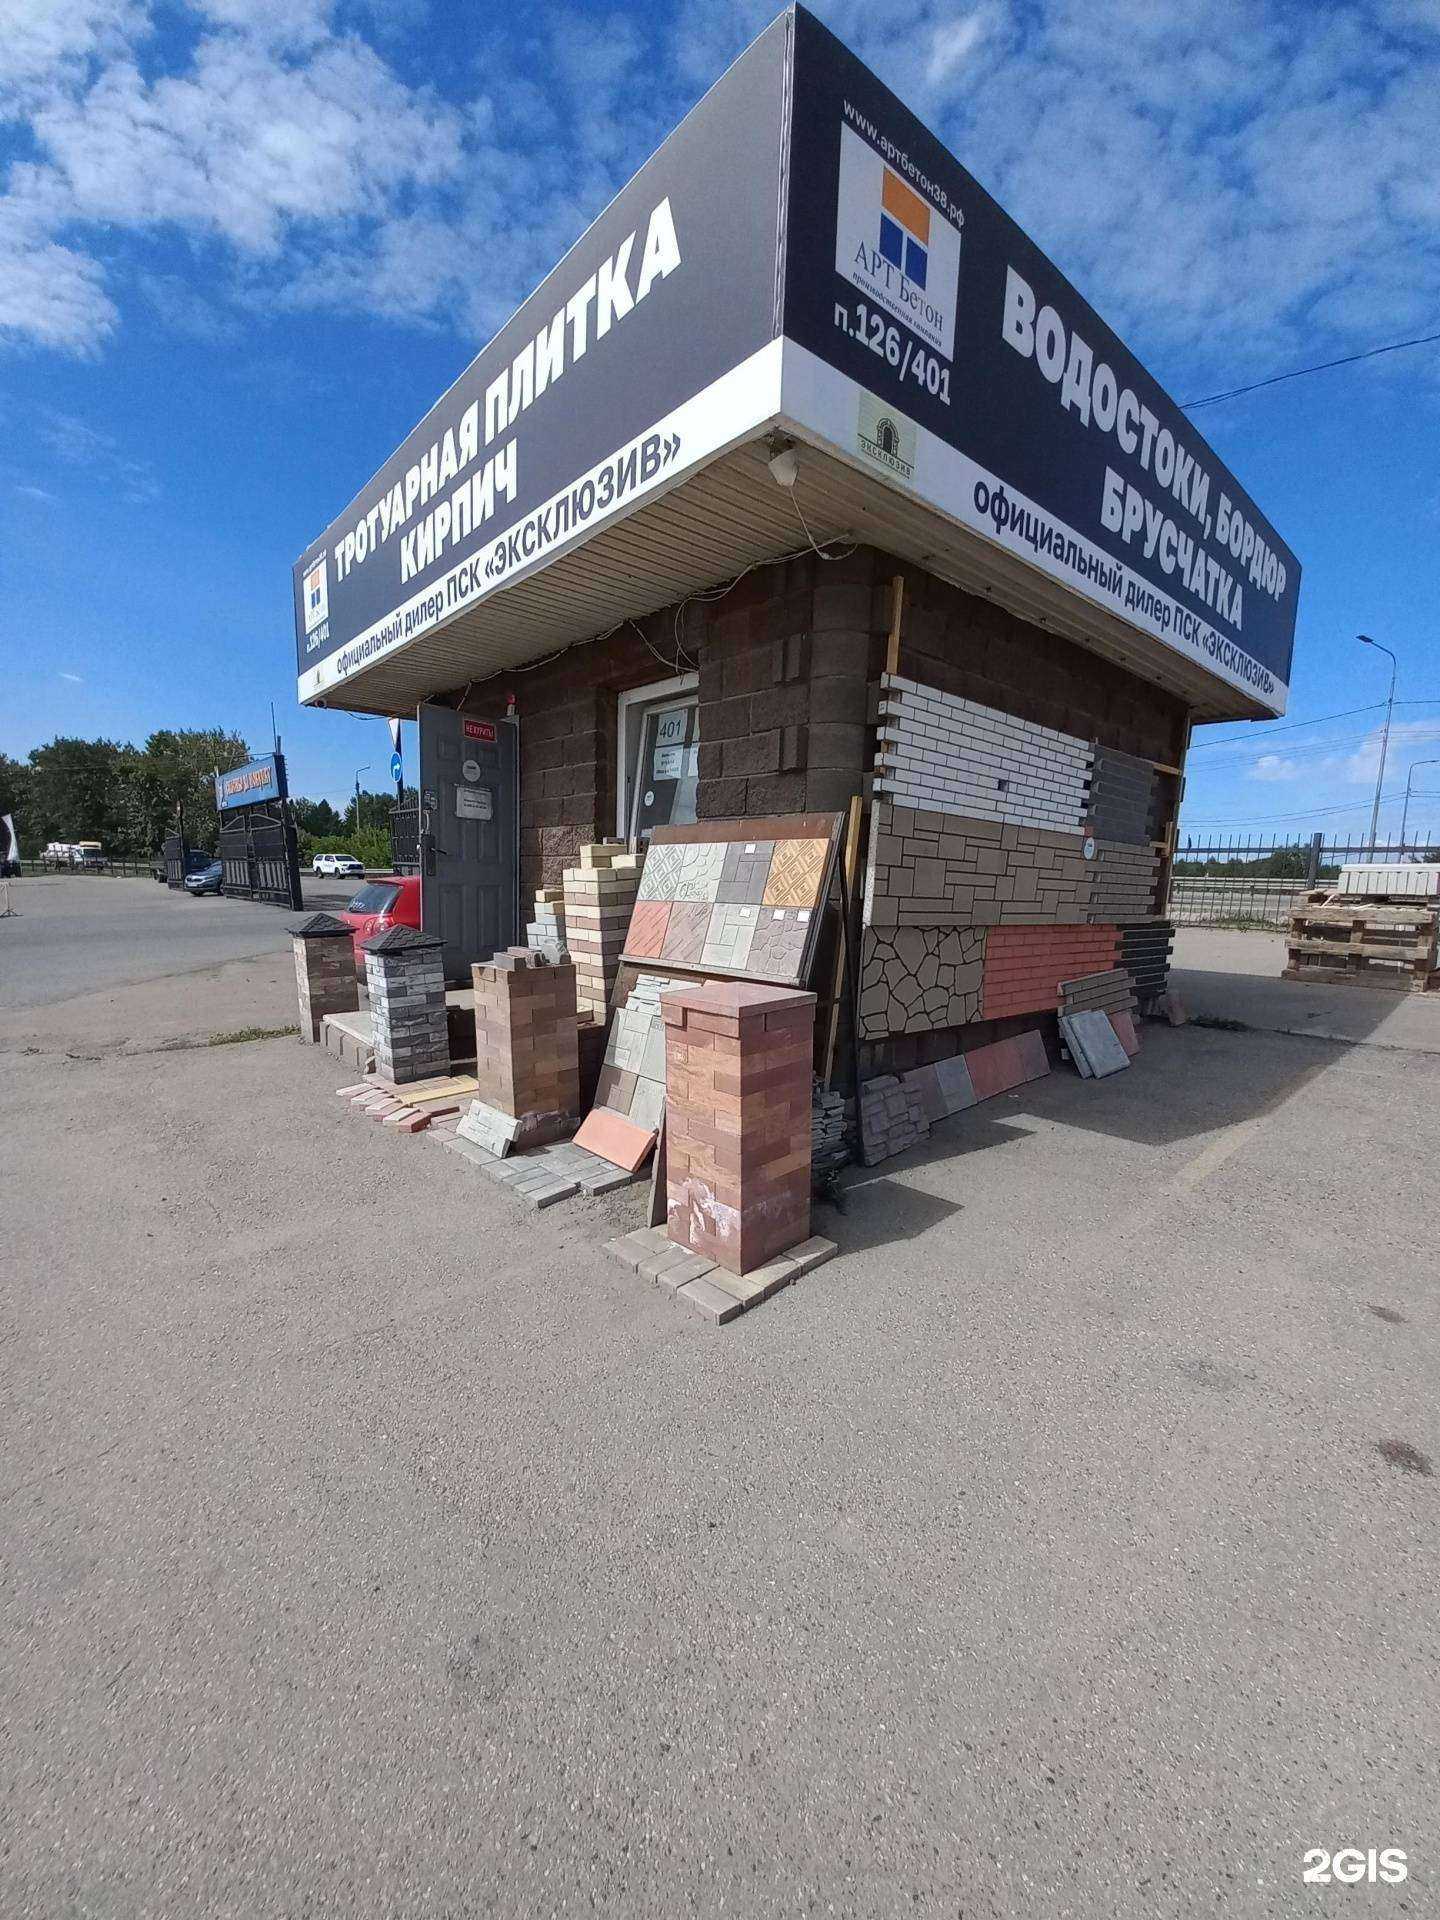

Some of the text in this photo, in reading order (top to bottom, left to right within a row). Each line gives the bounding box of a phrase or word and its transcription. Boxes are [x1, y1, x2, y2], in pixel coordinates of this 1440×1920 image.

[843, 99, 965, 227] www.артбетон38.рф
[854, 240, 894, 289] АРТ
[334, 196, 682, 582] ТРОТУАРНАЯ ПЛИТКА
[834, 301, 950, 406] п.126/401
[401, 437, 518, 584] КИРПИЧ
[1002, 264, 1287, 602] ВОДОСТОКИ, БОРДЮР
[336, 431, 681, 676] официальный дилер ПСК «ЭКСКЛЮЗИВ»
[973, 481, 1275, 695] официальный дилер ПСК «ЭКСКЛЮЗИВ»
[1100, 465, 1243, 631] БРУСЧАТКА
[659, 719, 681, 738] 401
